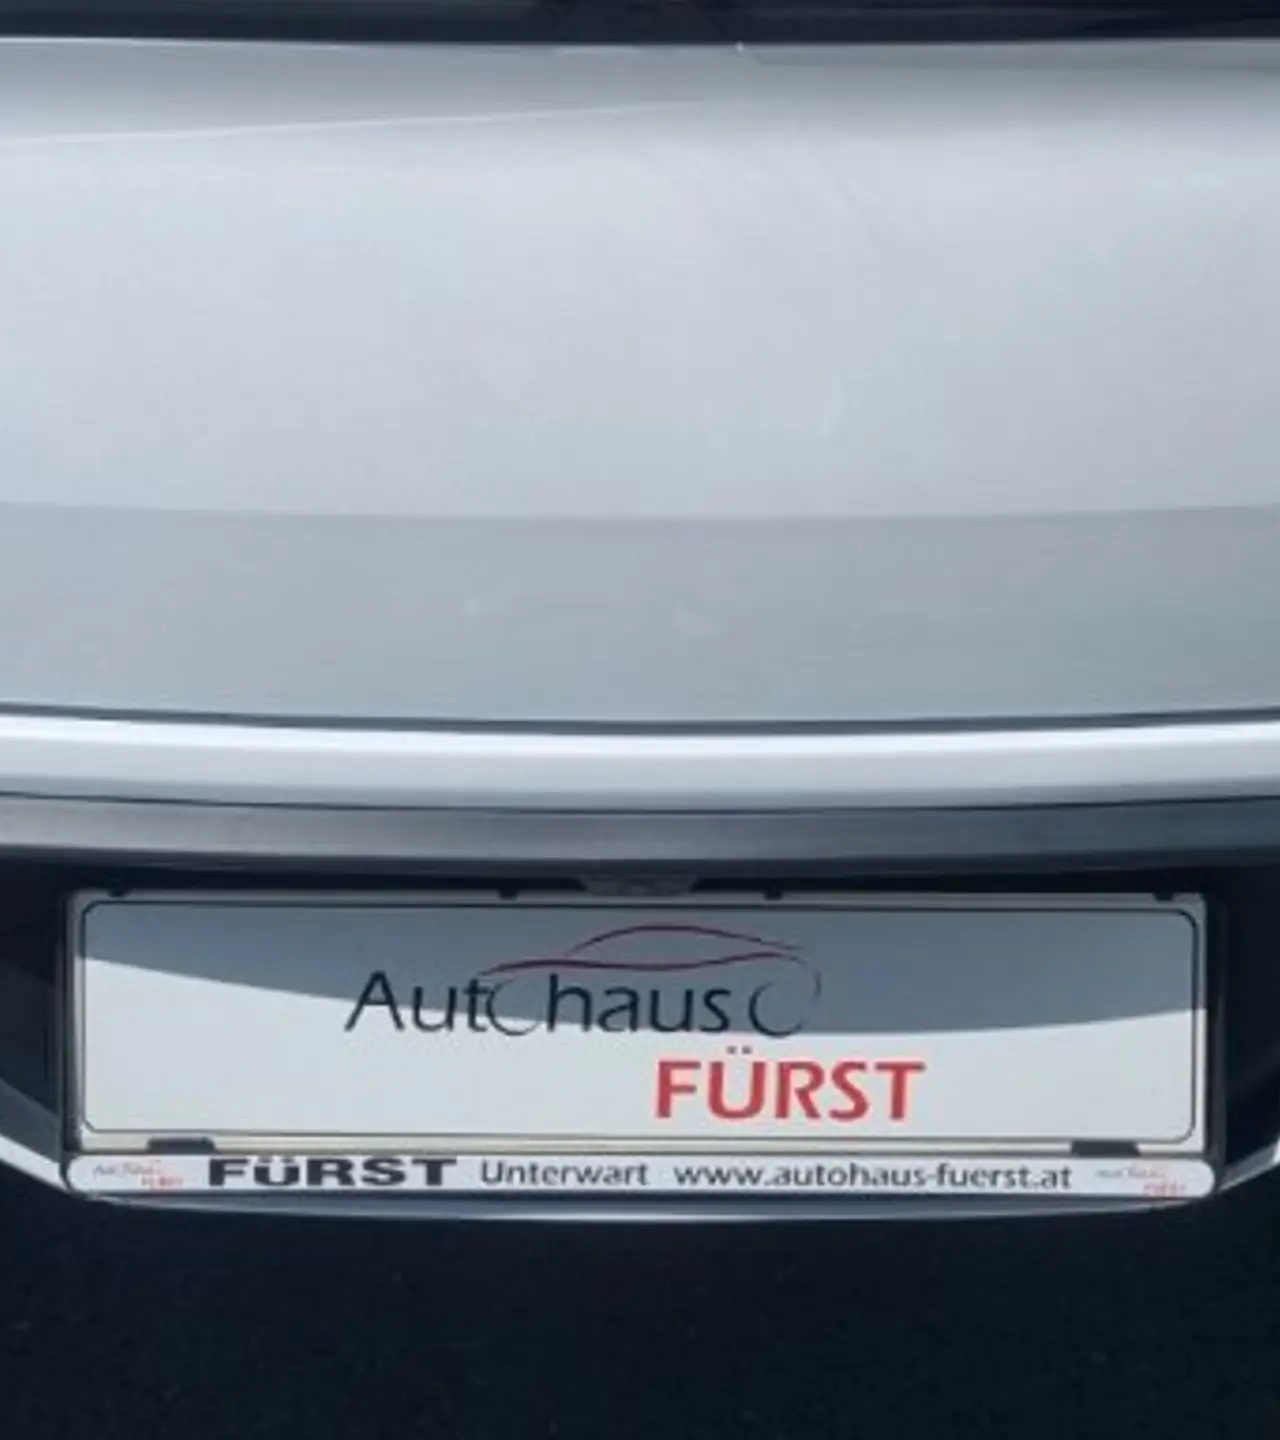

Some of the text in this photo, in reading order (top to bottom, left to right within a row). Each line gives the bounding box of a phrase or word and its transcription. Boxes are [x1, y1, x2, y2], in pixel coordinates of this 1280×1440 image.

[654, 1046, 926, 1121] FÜRST
[208, 1156, 458, 1187] FÜRST
[480, 1158, 651, 1187] Unterwart
[673, 1158, 1072, 1190] www.autohaus-fuerst.at
